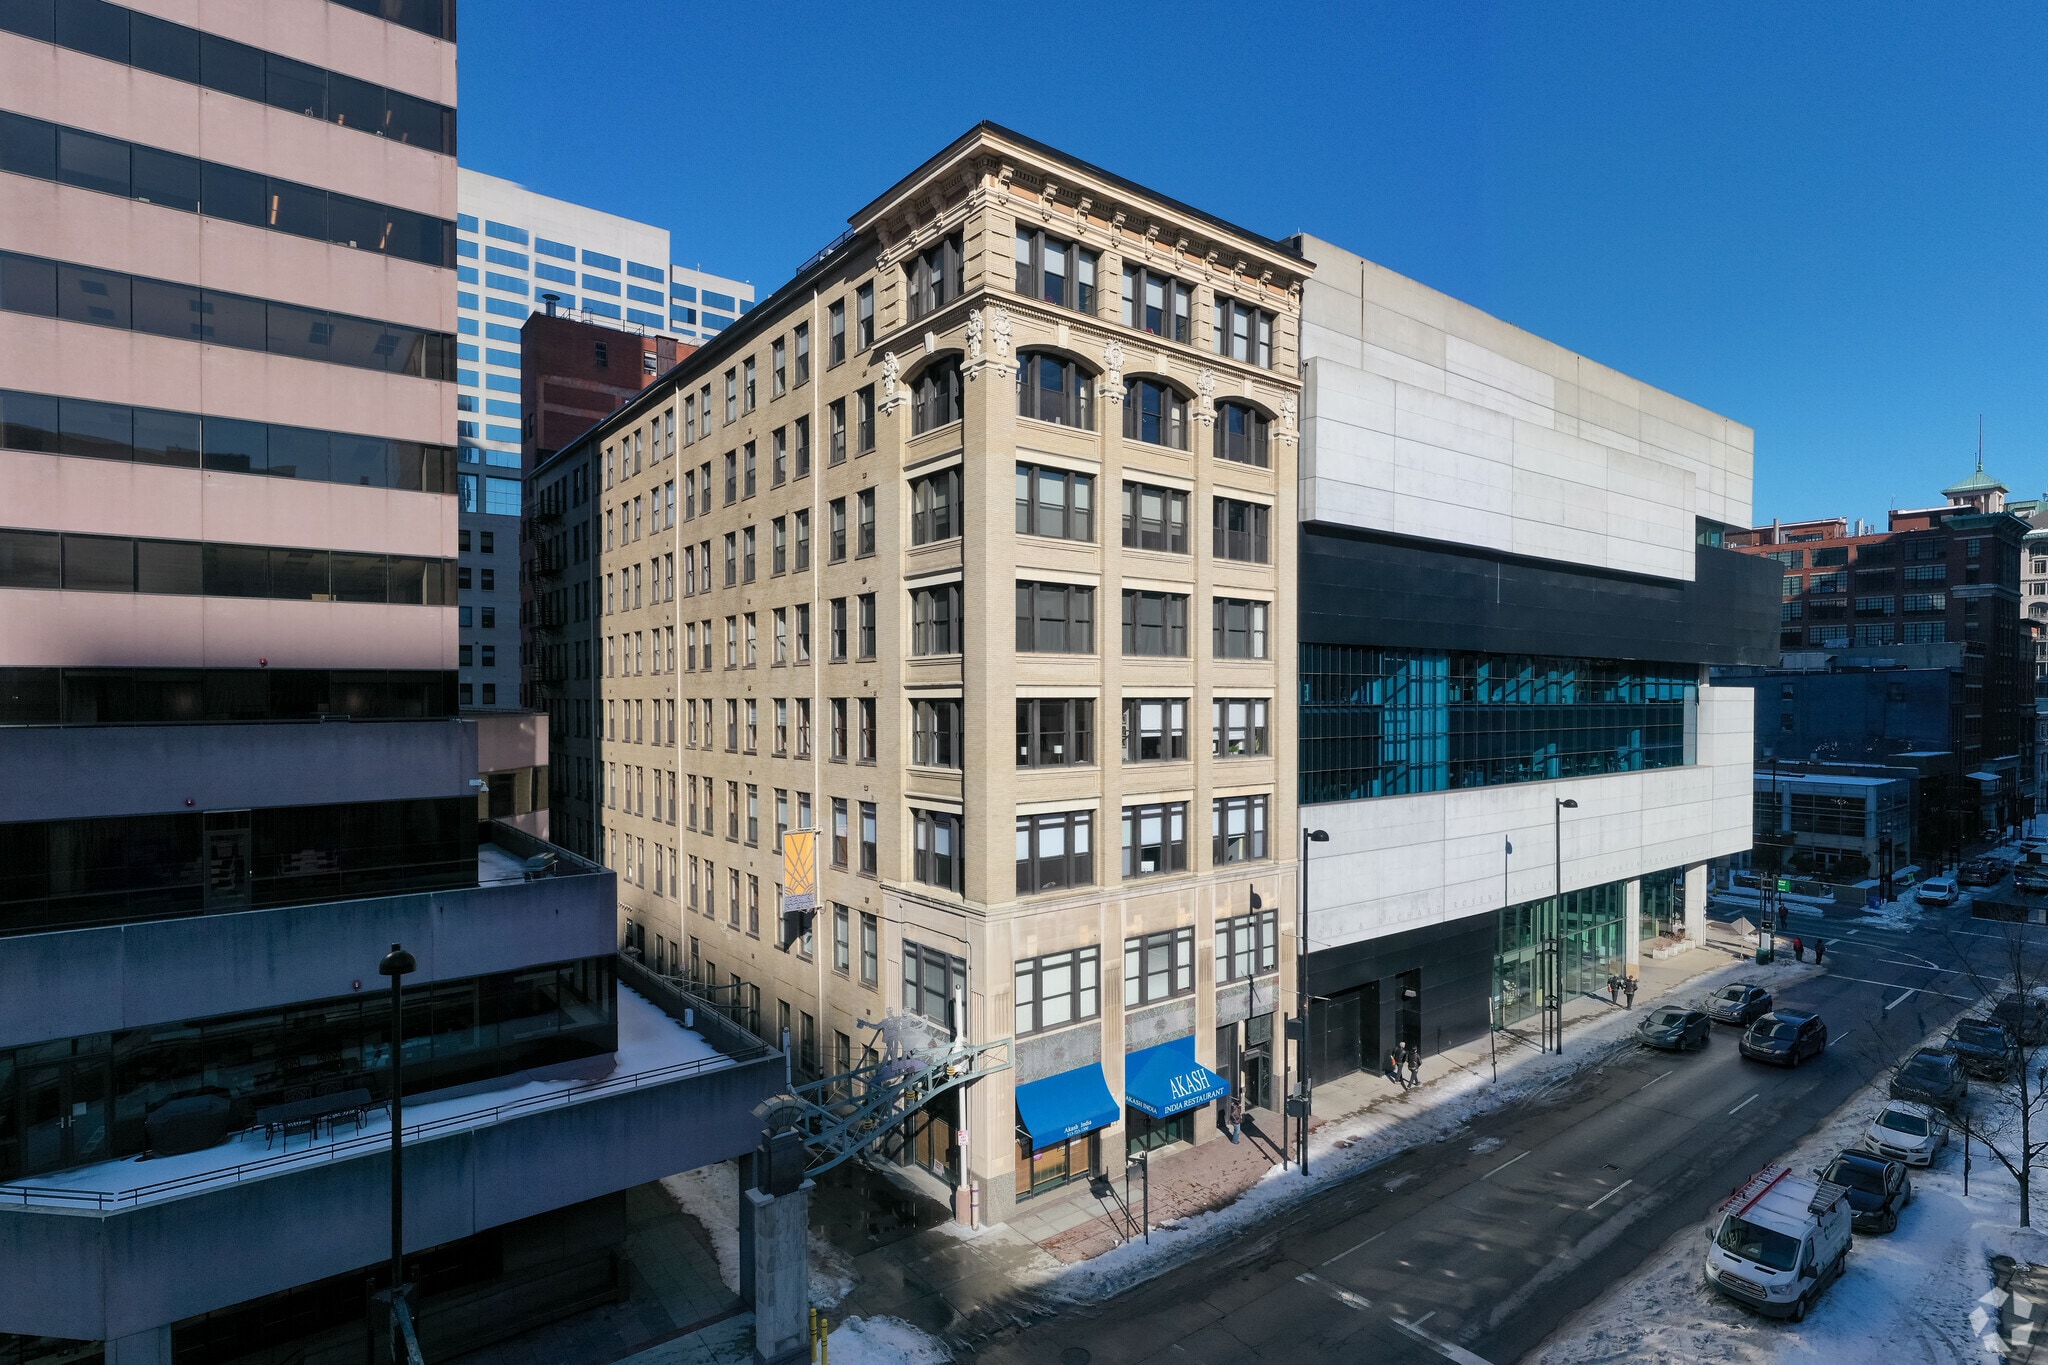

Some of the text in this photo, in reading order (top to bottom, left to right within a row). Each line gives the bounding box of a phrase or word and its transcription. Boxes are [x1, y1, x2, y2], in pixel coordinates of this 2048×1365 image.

[1169, 1068, 1211, 1099] AKASH
[1126, 1095, 1158, 1115] AKASH INDIA
[1164, 1087, 1225, 1115] INDIA RESTAURANT
[1063, 1120, 1092, 1134] Akash India
